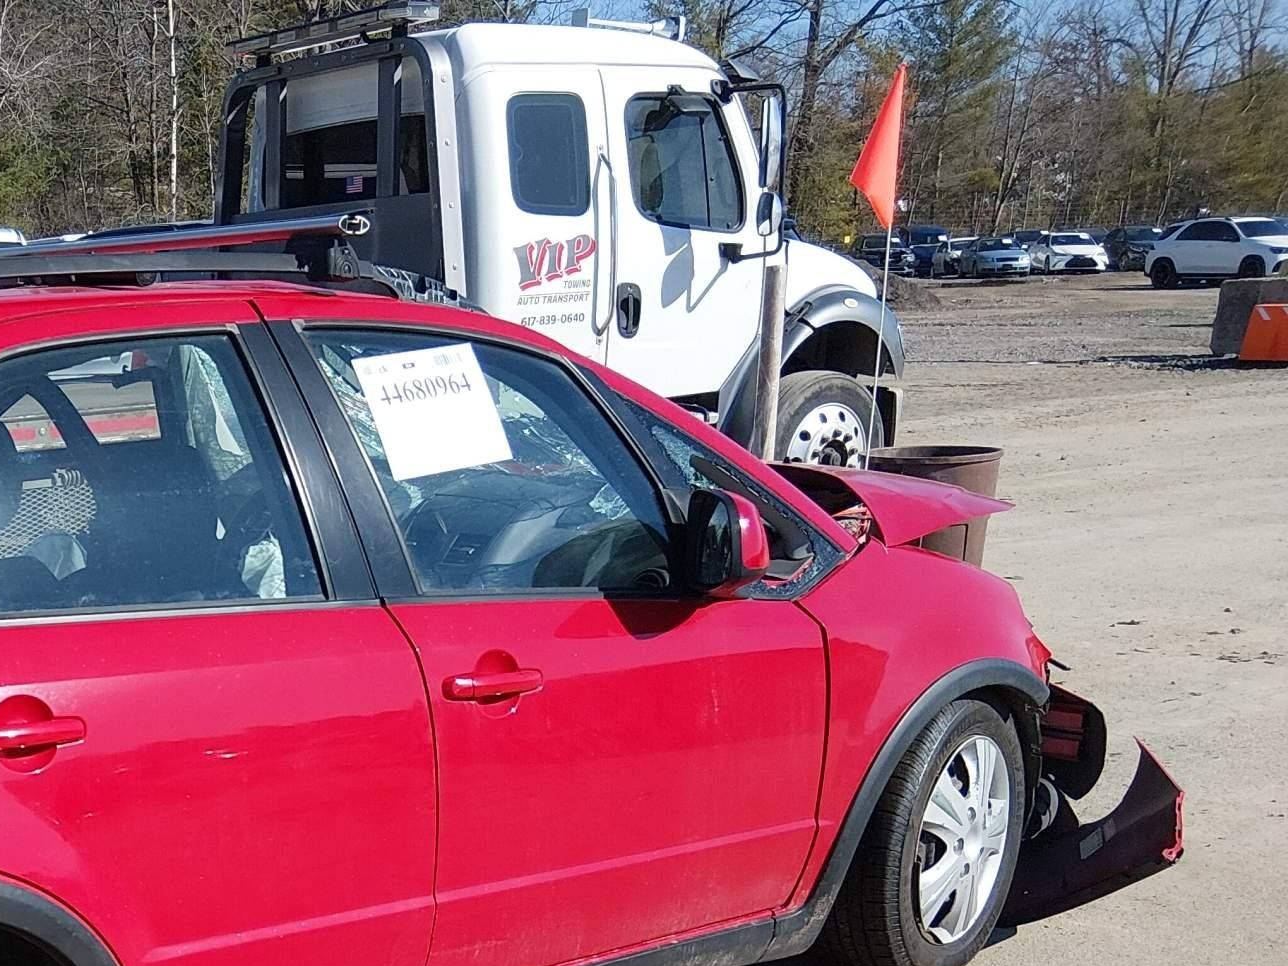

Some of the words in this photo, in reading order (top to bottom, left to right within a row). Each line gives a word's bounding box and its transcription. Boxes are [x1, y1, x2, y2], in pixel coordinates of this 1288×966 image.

[513, 234, 596, 291] VIP
[563, 279, 592, 289] TOWING
[517, 296, 540, 306] AUTO
[542, 294, 591, 304] TRANSPORT
[520, 312, 586, 327] 617-839-0640
[380, 371, 472, 406] 44680964
